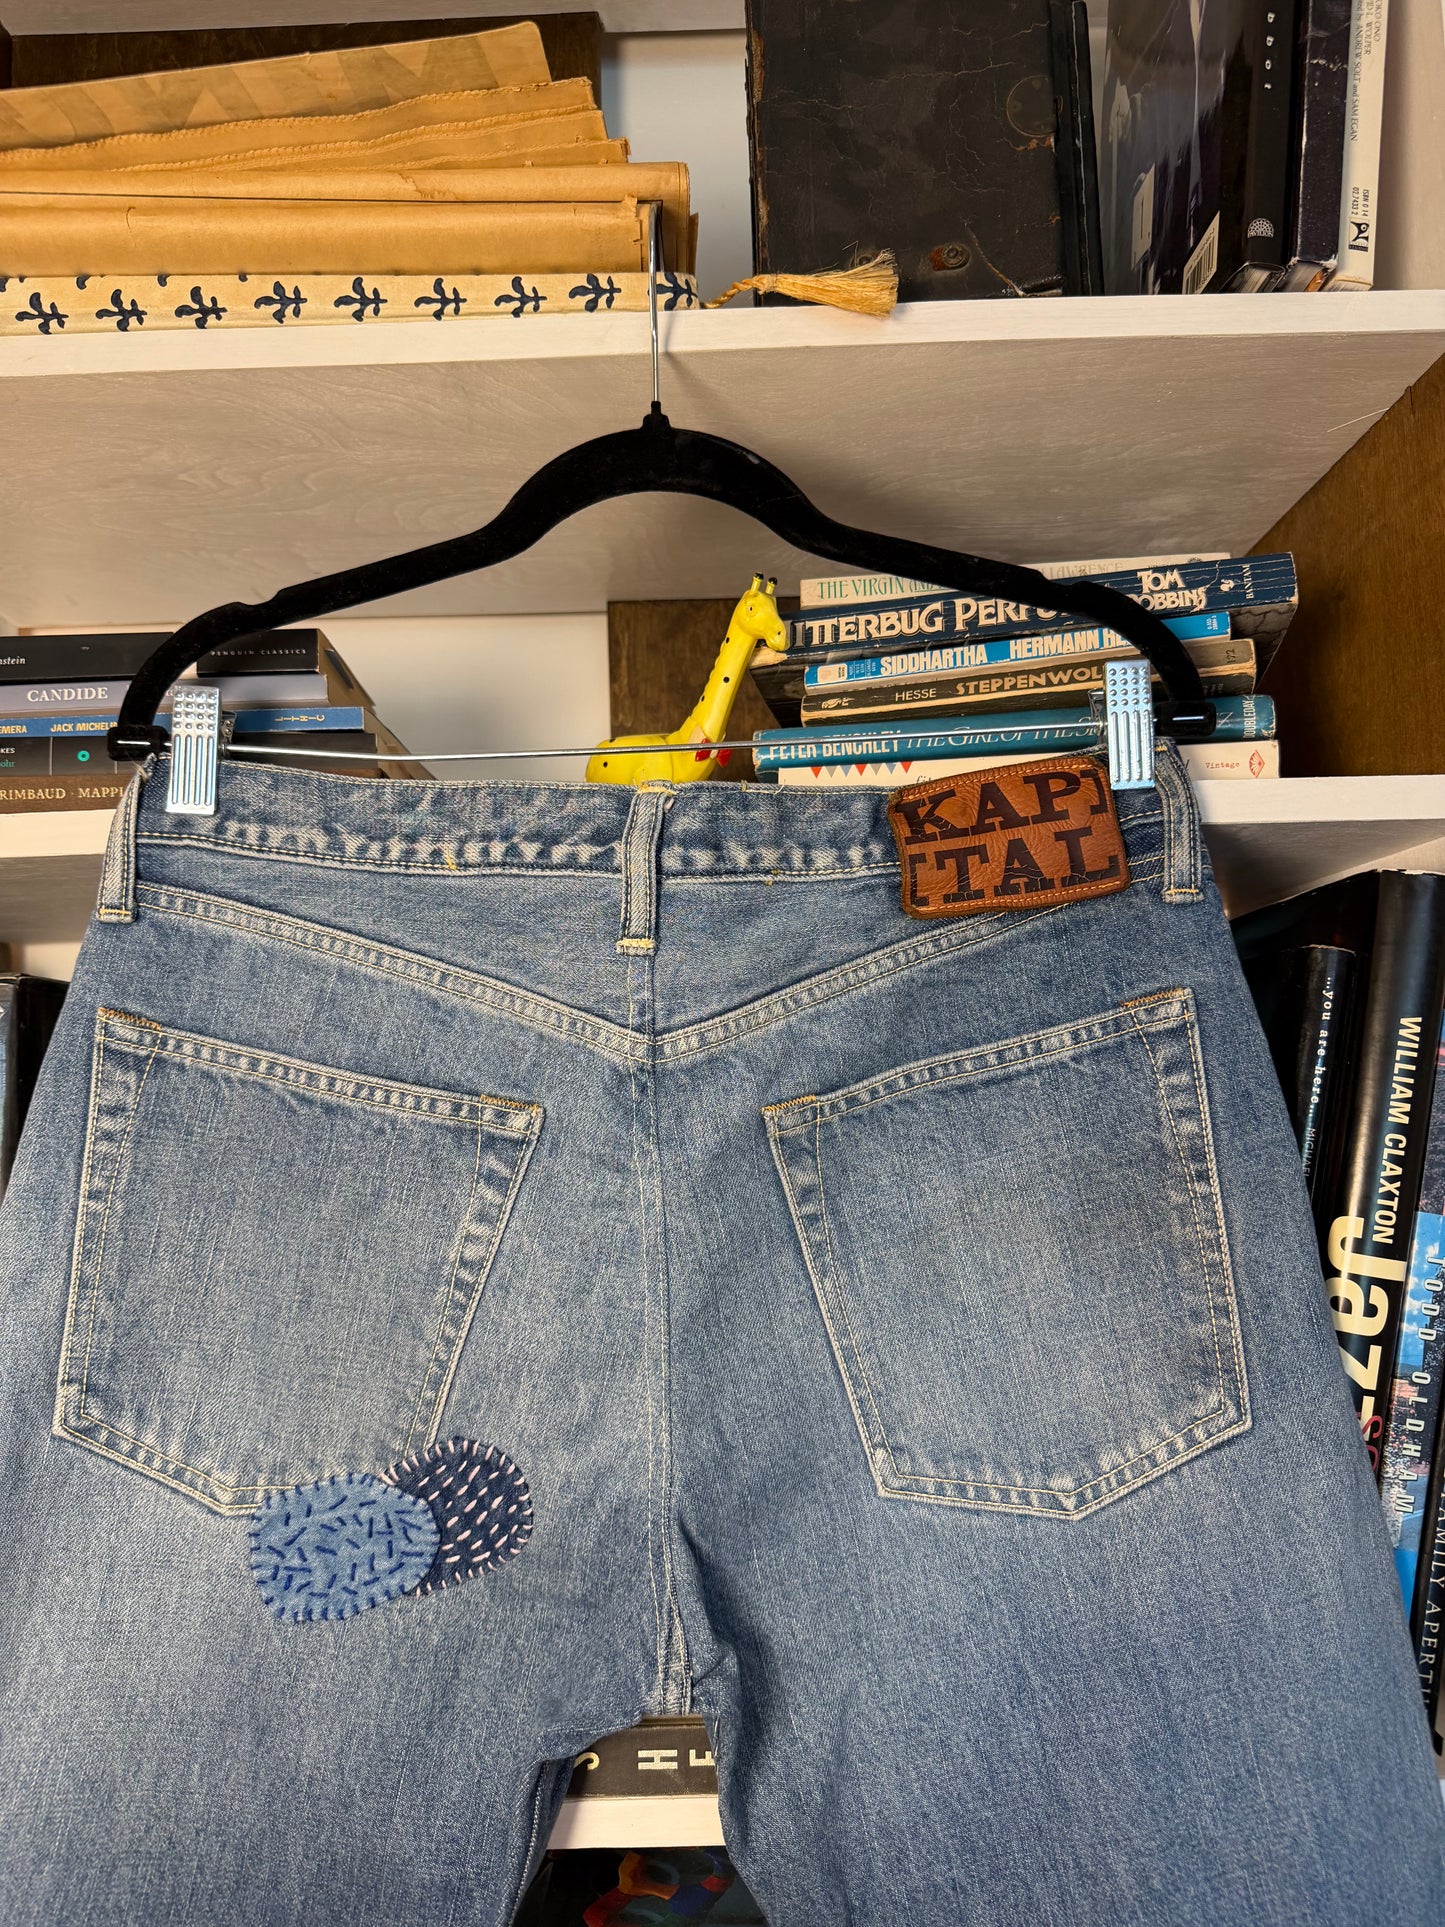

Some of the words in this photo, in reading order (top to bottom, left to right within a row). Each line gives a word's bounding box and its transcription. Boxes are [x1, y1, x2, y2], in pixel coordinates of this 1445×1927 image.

[1354, 25, 1363, 59] ANDREW
[1363, 21, 1372, 55] WOLPER
[1353, 62, 1362, 82] SOLT
[1352, 84, 1360, 97] and
[1351, 98, 1359, 116] SAM
[1350, 118, 1358, 142] EGAN
[1362, 189, 1370, 202] ISBN
[818, 579, 849, 600] THE
[852, 576, 905, 597] VIRGIN
[1137, 568, 1186, 593] TOM
[1242, 564, 1255, 599] BANTAM
[260, 648, 307, 656] CLASSICS
[880, 645, 988, 676] SIDDHARTHA
[1009, 629, 1100, 660] HERMANN
[1103, 628, 1131, 649] HE
[27, 686, 108, 702] CANDIDE
[895, 688, 937, 702] HESSE
[955, 666, 1103, 696] STEPPENWOL
[50, 723, 74, 732] JACK
[1242, 700, 1257, 739] DOUBLEDAY
[769, 737, 817, 760] PETER
[822, 730, 901, 757] BENCHLEY
[1205, 761, 1240, 769] Vintage
[0, 787, 66, 800] RIMBAUD
[1316, 1030, 1329, 1056] are
[1387, 1016, 1423, 1125] WILLIAM
[1371, 1133, 1406, 1245] CLAXTON
[1415, 1256, 1445, 1342] TODD
[1394, 1371, 1431, 1514] OLDHAM
